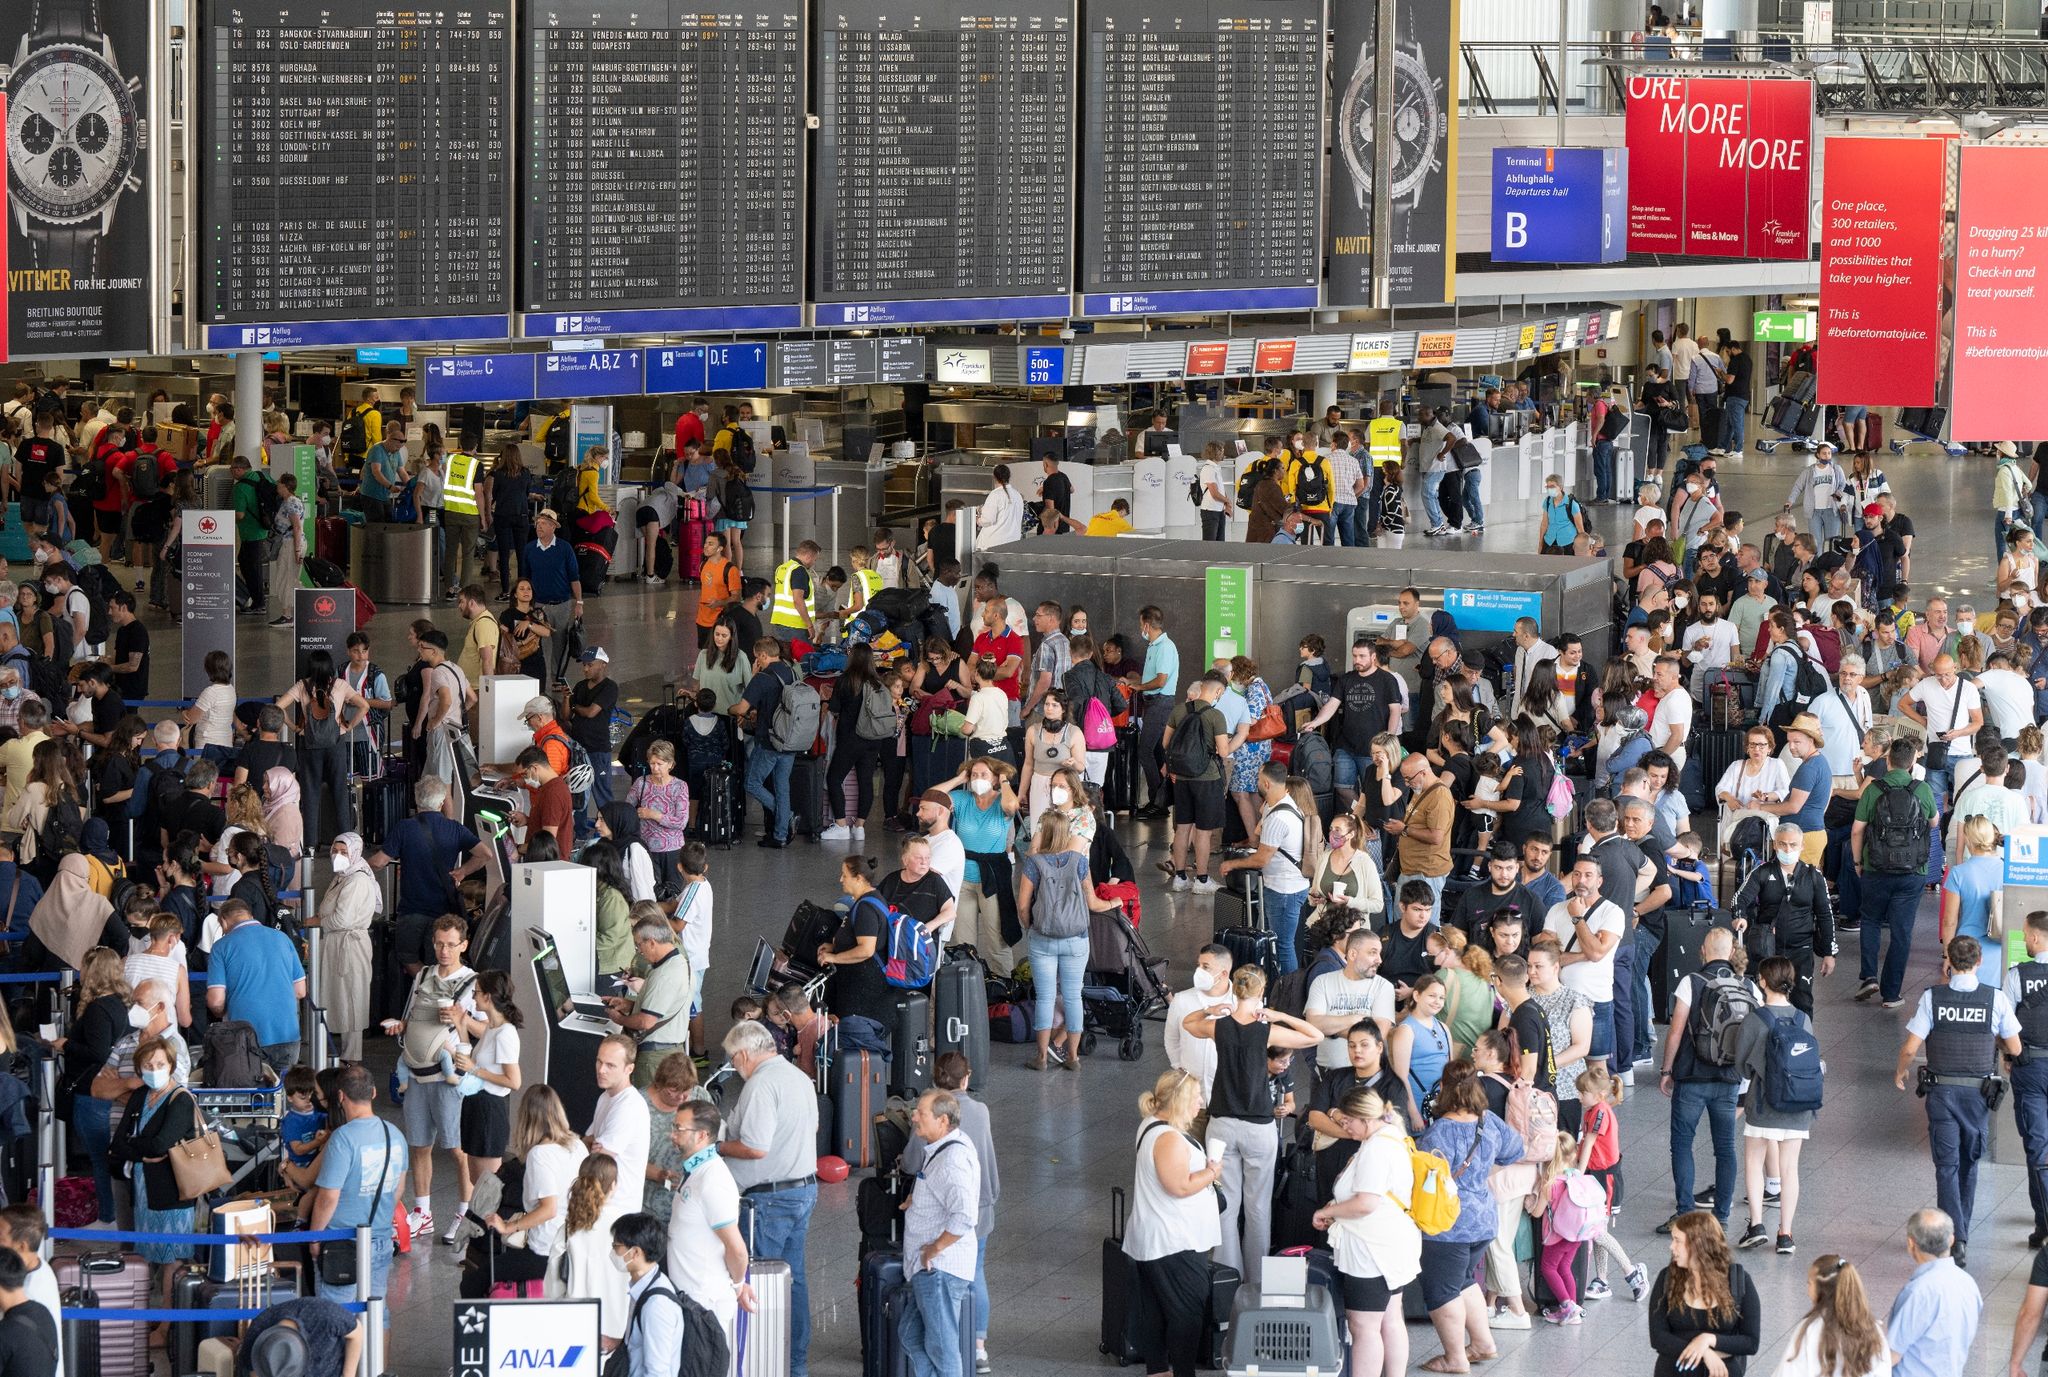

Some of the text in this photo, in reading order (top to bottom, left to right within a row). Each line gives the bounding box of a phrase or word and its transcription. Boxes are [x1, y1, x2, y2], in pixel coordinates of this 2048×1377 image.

[233, 30, 242, 38] TG
[256, 30, 270, 38] 923
[233, 41, 242, 49] LH
[280, 41, 350, 50] OSLO-GARDERMOEN
[252, 64, 270, 72] 8578
[280, 64, 317, 72] HURGHADA
[592, 74, 668, 82] BERLIN-BRANDENBURG
[233, 108, 340, 117] LH 3402 STUTTGART HBF
[1660, 103, 1743, 134] MORE
[280, 143, 331, 151] LONDON-CITY
[1719, 138, 1803, 170] MORE
[1506, 157, 1542, 166] Terminal
[1506, 174, 1554, 185] Abflughalle
[1505, 186, 1569, 197] Departures hall
[1832, 201, 1887, 213] One place,
[1831, 218, 1898, 231] 300 retailers,
[1506, 212, 1527, 248] B
[1605, 214, 1611, 248] B
[1969, 226, 2018, 240] Dragging
[2021, 227, 2034, 238] 25
[1692, 231, 1738, 241] Miles & More
[1831, 237, 1881, 247] and 1000
[1394, 244, 1406, 253] FOR
[1417, 244, 1440, 252] JOURNEY
[1969, 247, 1978, 256] in
[1991, 247, 2024, 260] hurry?
[280, 256, 312, 264] ANTALYA
[1830, 255, 1912, 267] possibilities that
[1968, 266, 2035, 278] Check-in and
[8, 269, 142, 292] VITIMER FOR THE JOURNEY
[1829, 273, 1912, 287] take you higher.
[280, 287, 367, 298] NUERNBERG-WUERZBURG
[591, 291, 624, 299] HELSINKI
[1967, 287, 2036, 300] treat yourself.
[27, 306, 102, 318] BREITLING BOUTIQUE
[870, 306, 885, 314] Abflug
[1829, 309, 1860, 319] This is
[584, 316, 600, 324] Abflug
[584, 324, 611, 332] Departures
[1966, 327, 1997, 337] This is
[1827, 328, 1928, 341] #beforetomatojuice.
[1356, 341, 1389, 350] TICKETS
[589, 354, 620, 370] A,B,Z
[711, 350, 728, 366] D,E
[456, 360, 472, 368] Abflug
[485, 360, 493, 374] C
[560, 363, 587, 371] Departures
[1031, 359, 1054, 368] 500-
[456, 368, 483, 377] Departures
[1031, 372, 1048, 381] 570
[988, 745, 1007, 754] adidas
[1938, 1006, 1986, 1022] POLIZEI
[500, 1349, 554, 1368] ANA
